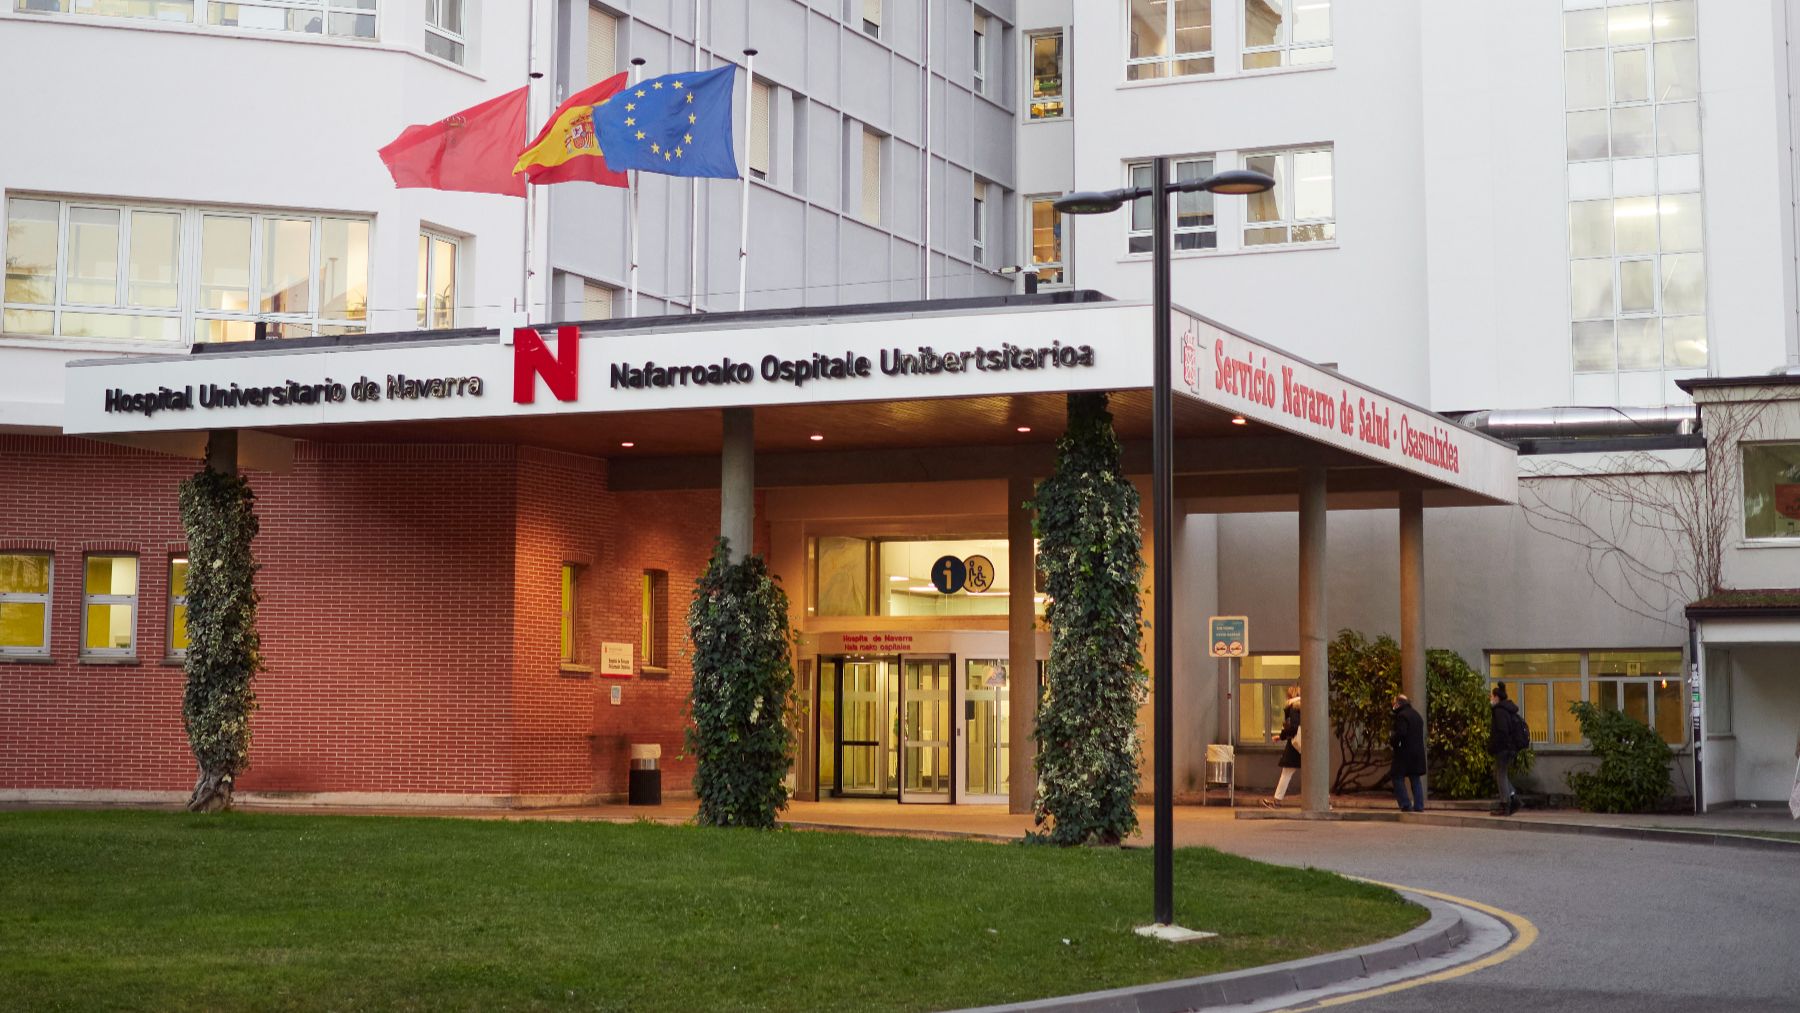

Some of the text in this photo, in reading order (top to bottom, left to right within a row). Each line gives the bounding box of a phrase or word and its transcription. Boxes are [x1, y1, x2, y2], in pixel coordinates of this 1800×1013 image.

[512, 324, 582, 405] N
[610, 340, 1096, 390] Nafarroako Ospitale Unibertsitarioa
[104, 373, 484, 418] Hospital Universitario de Navarra
[1214, 338, 1460, 473] Servicio Navarro de Salud Osasunbidea
[872, 634, 882, 642] de
